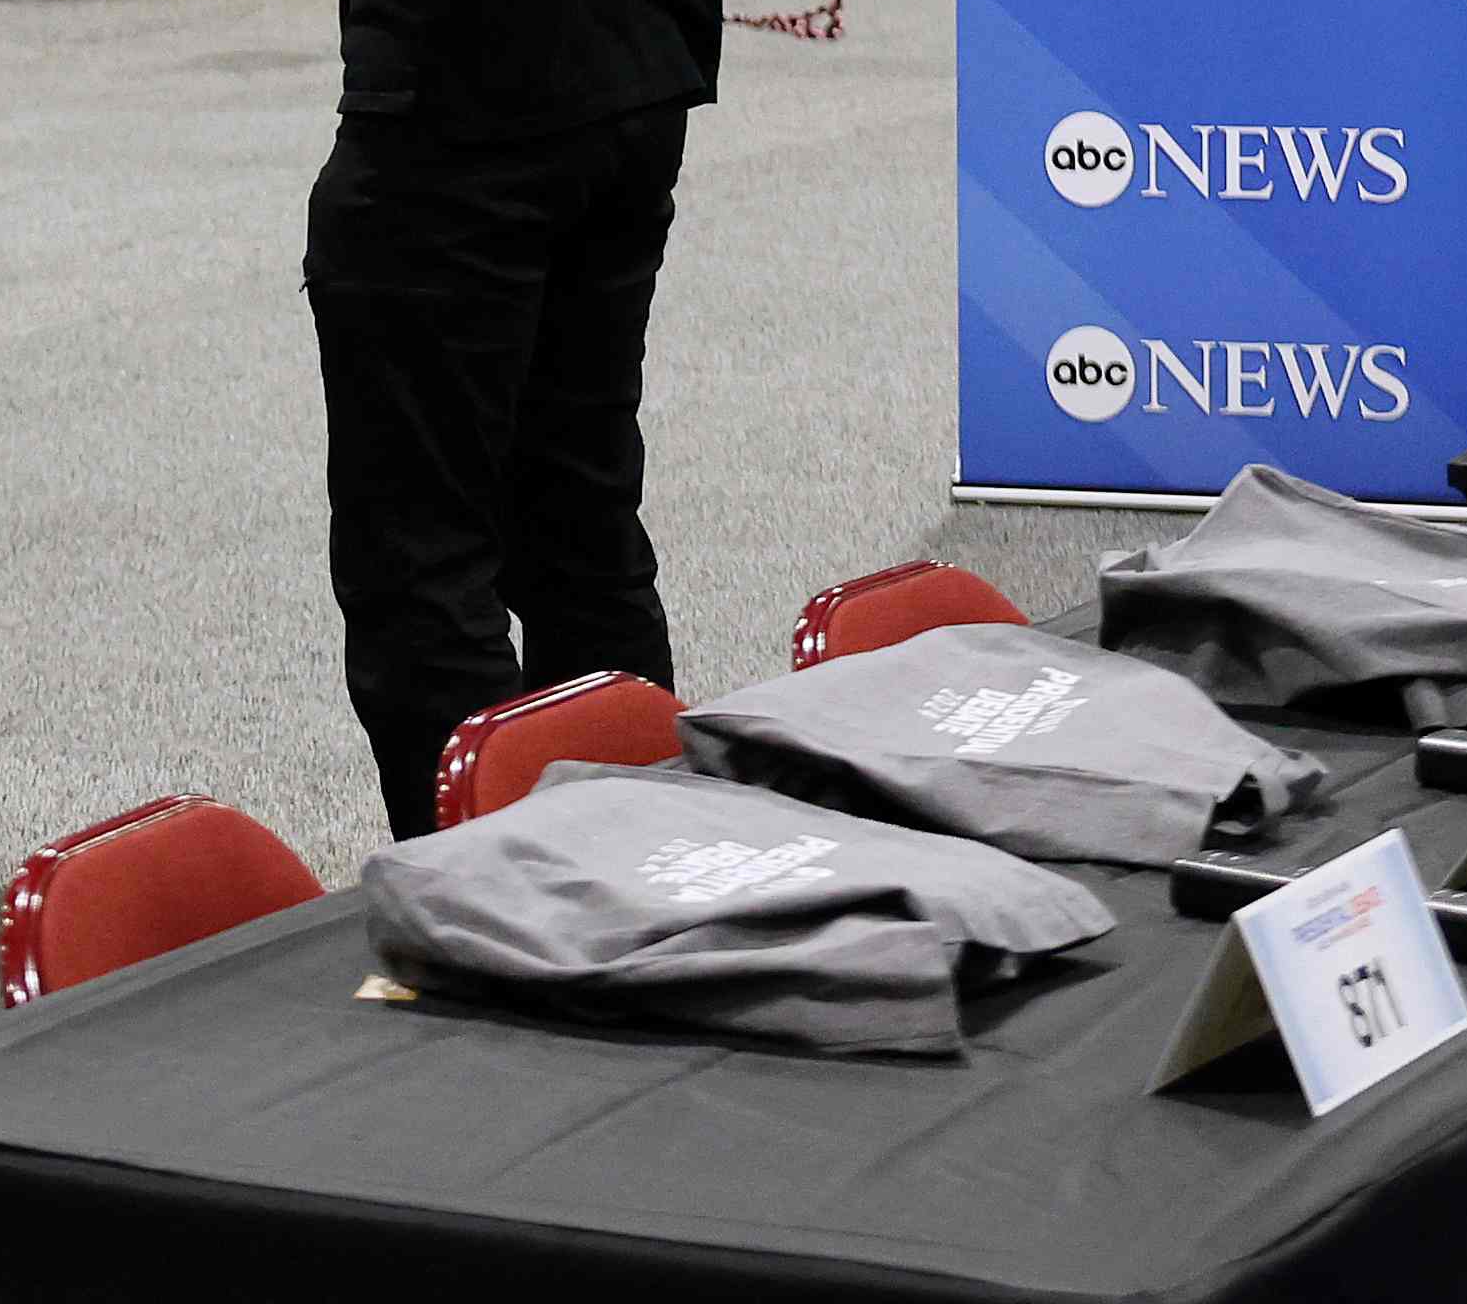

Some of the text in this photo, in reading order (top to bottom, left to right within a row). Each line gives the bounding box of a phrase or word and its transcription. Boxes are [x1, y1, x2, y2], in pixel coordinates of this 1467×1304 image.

[1051, 123, 1408, 204] abc NEWS
[1052, 337, 1410, 422] abc NEWS
